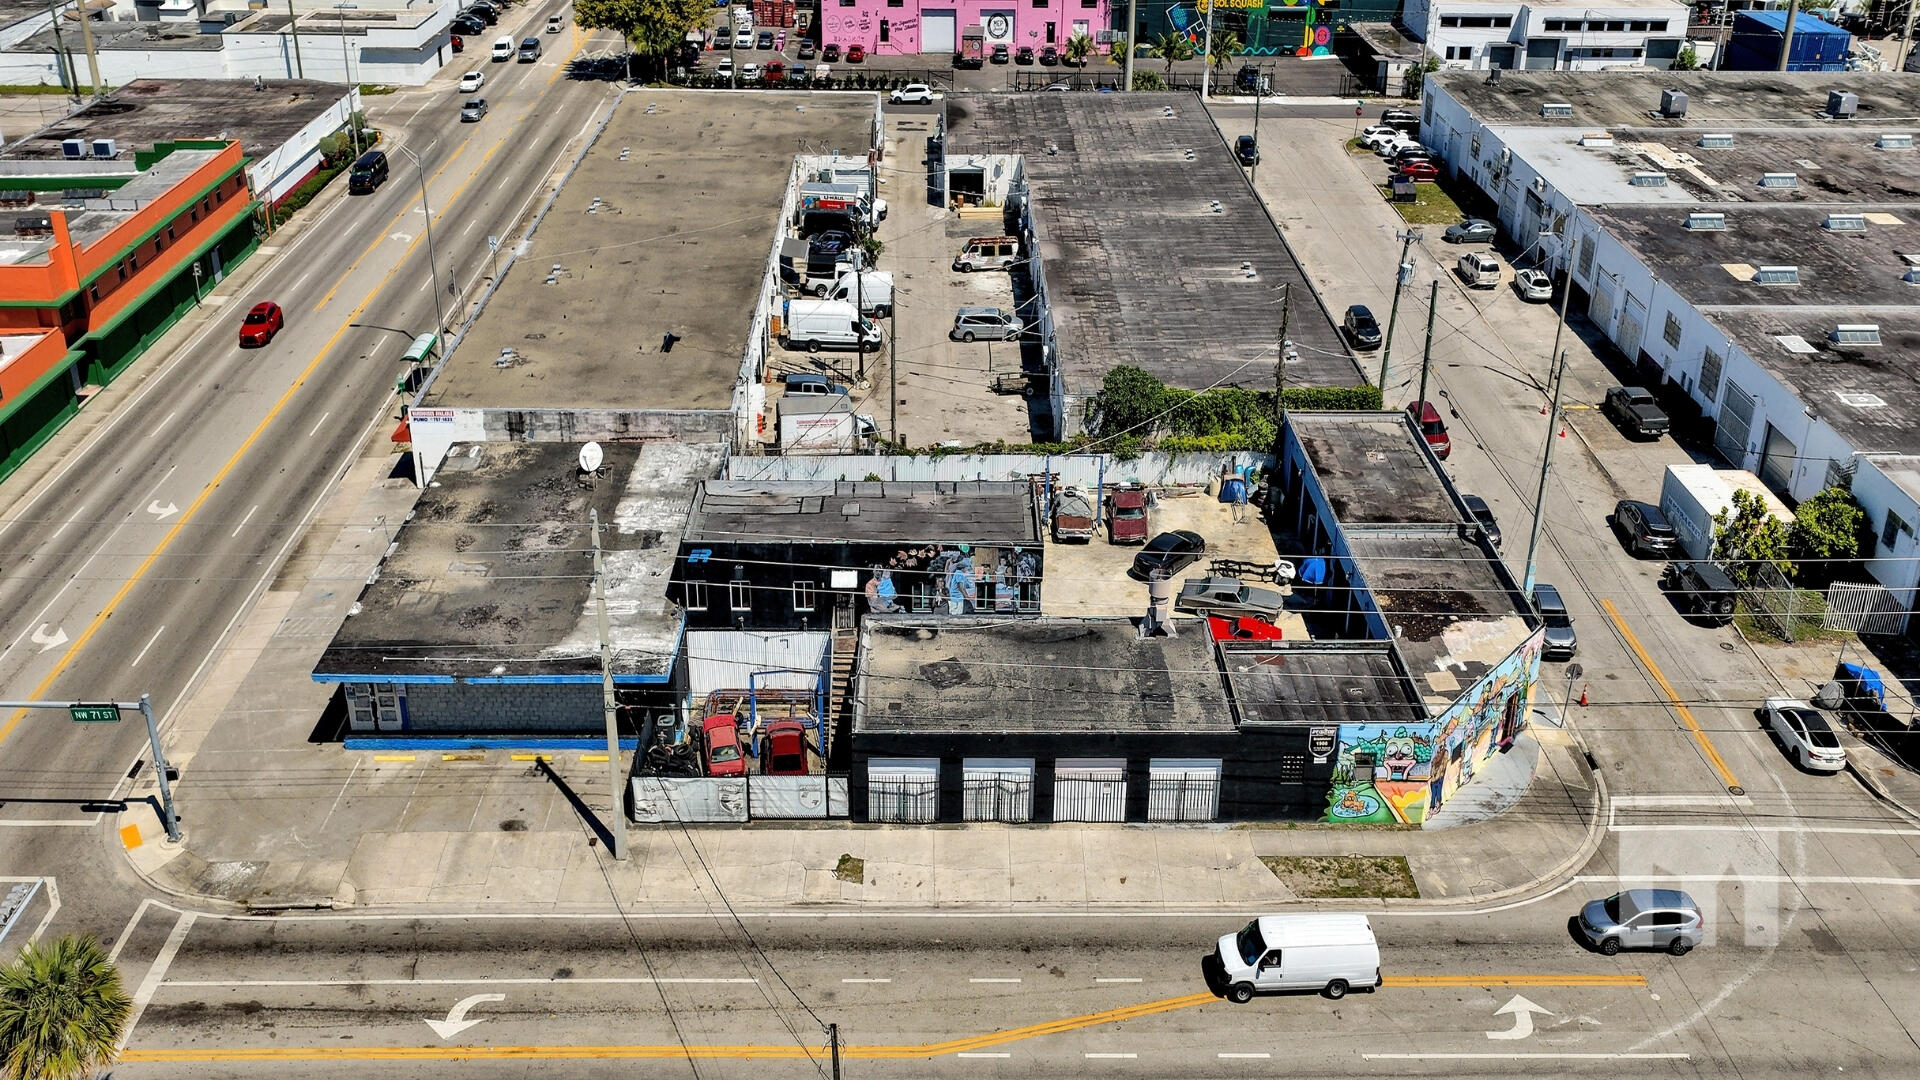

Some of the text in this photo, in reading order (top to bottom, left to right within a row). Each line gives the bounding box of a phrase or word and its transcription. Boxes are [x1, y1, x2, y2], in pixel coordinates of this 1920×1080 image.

[1213, 0, 1263, 9] SOL SQUASH
[74, 710, 113, 719] NW 71 ST
